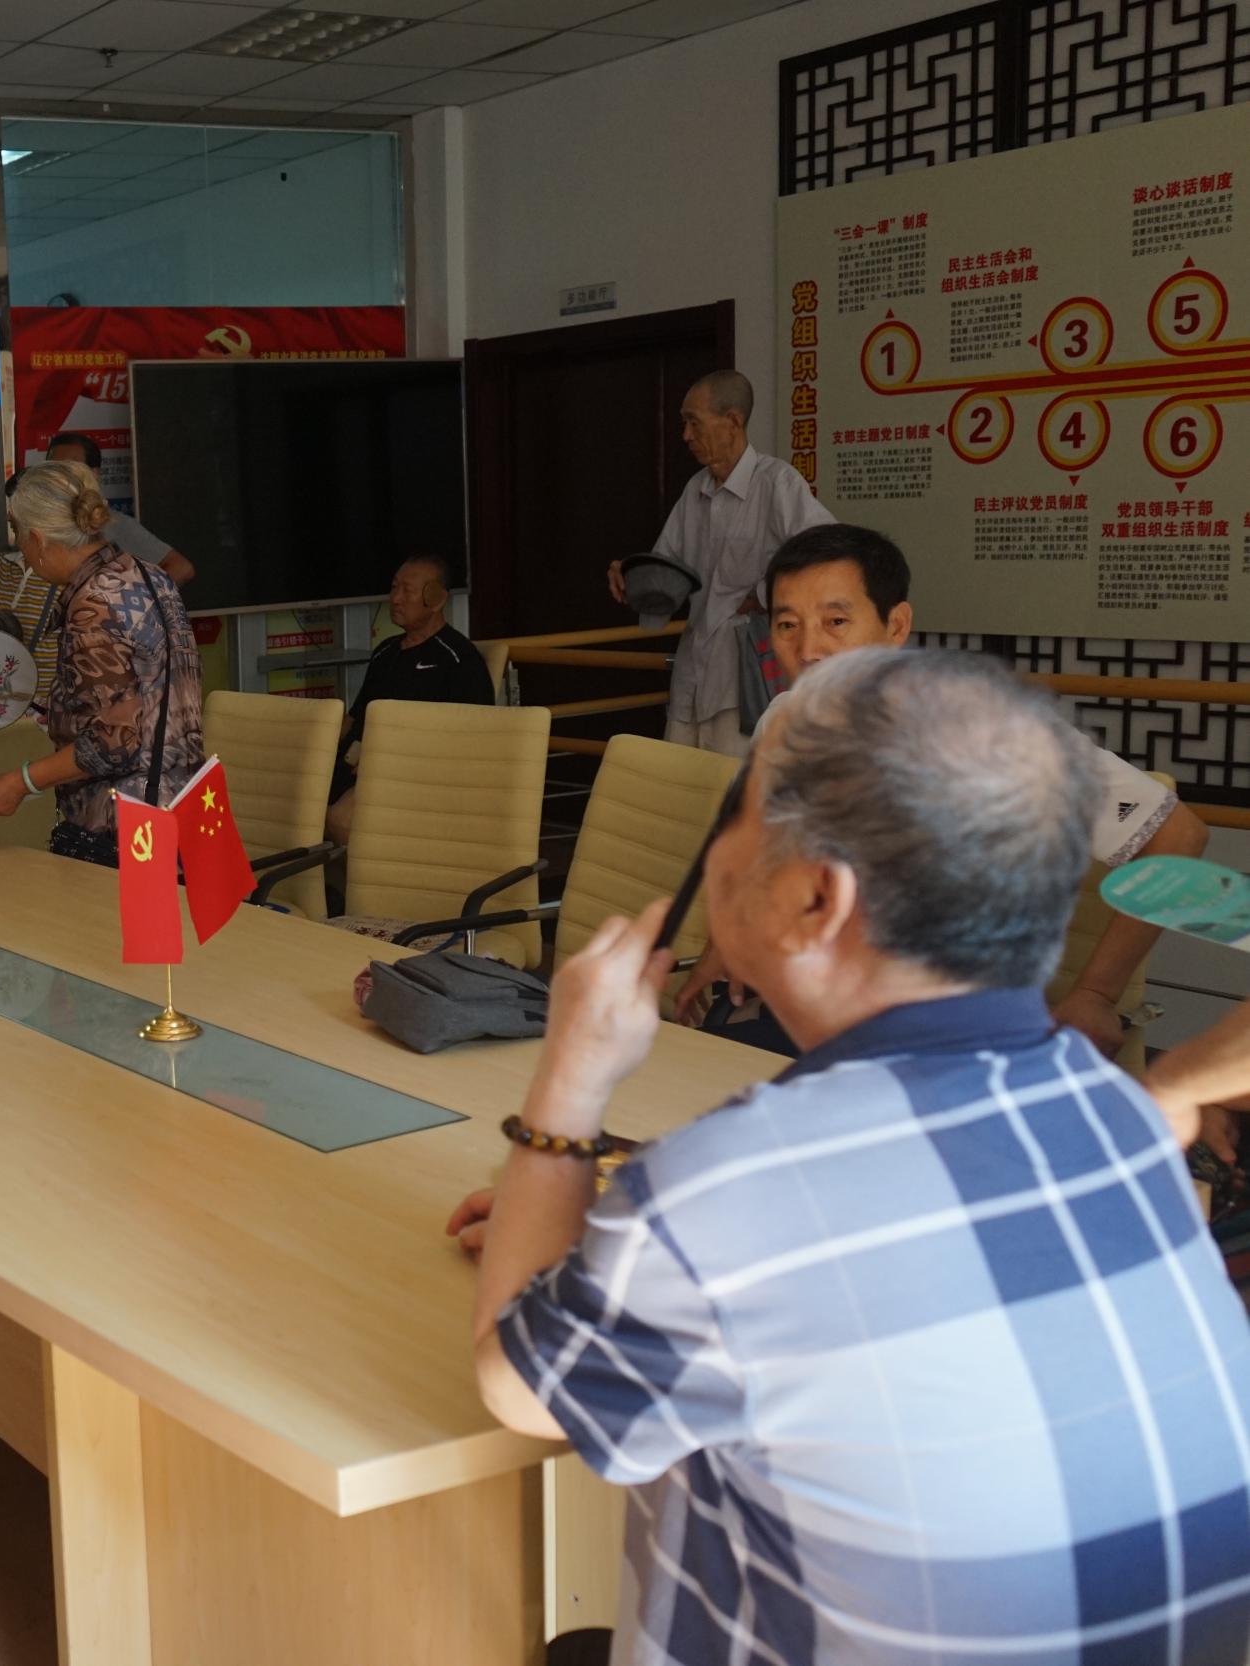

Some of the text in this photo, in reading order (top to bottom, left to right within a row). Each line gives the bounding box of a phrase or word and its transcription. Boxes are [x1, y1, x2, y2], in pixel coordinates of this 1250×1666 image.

[1133, 171, 1233, 204] 谈心谈话制度
[948, 247, 1032, 273] 民主生活会和
[942, 265, 1038, 293] 组织生活会制度
[1173, 294, 1200, 336] 5
[1063, 319, 1089, 358] 3
[879, 342, 895, 377] 1
[792, 281, 817, 495] 党组织生活制
[833, 424, 930, 444] 支部主题党日制度
[969, 407, 993, 444] 2
[1059, 411, 1086, 449] 4
[1170, 415, 1198, 457] 6
[974, 494, 1088, 512] 民主评议党员制度
[1117, 500, 1213, 518] 党员领导干部
[1101, 520, 1229, 538] 双重组织生活制度
